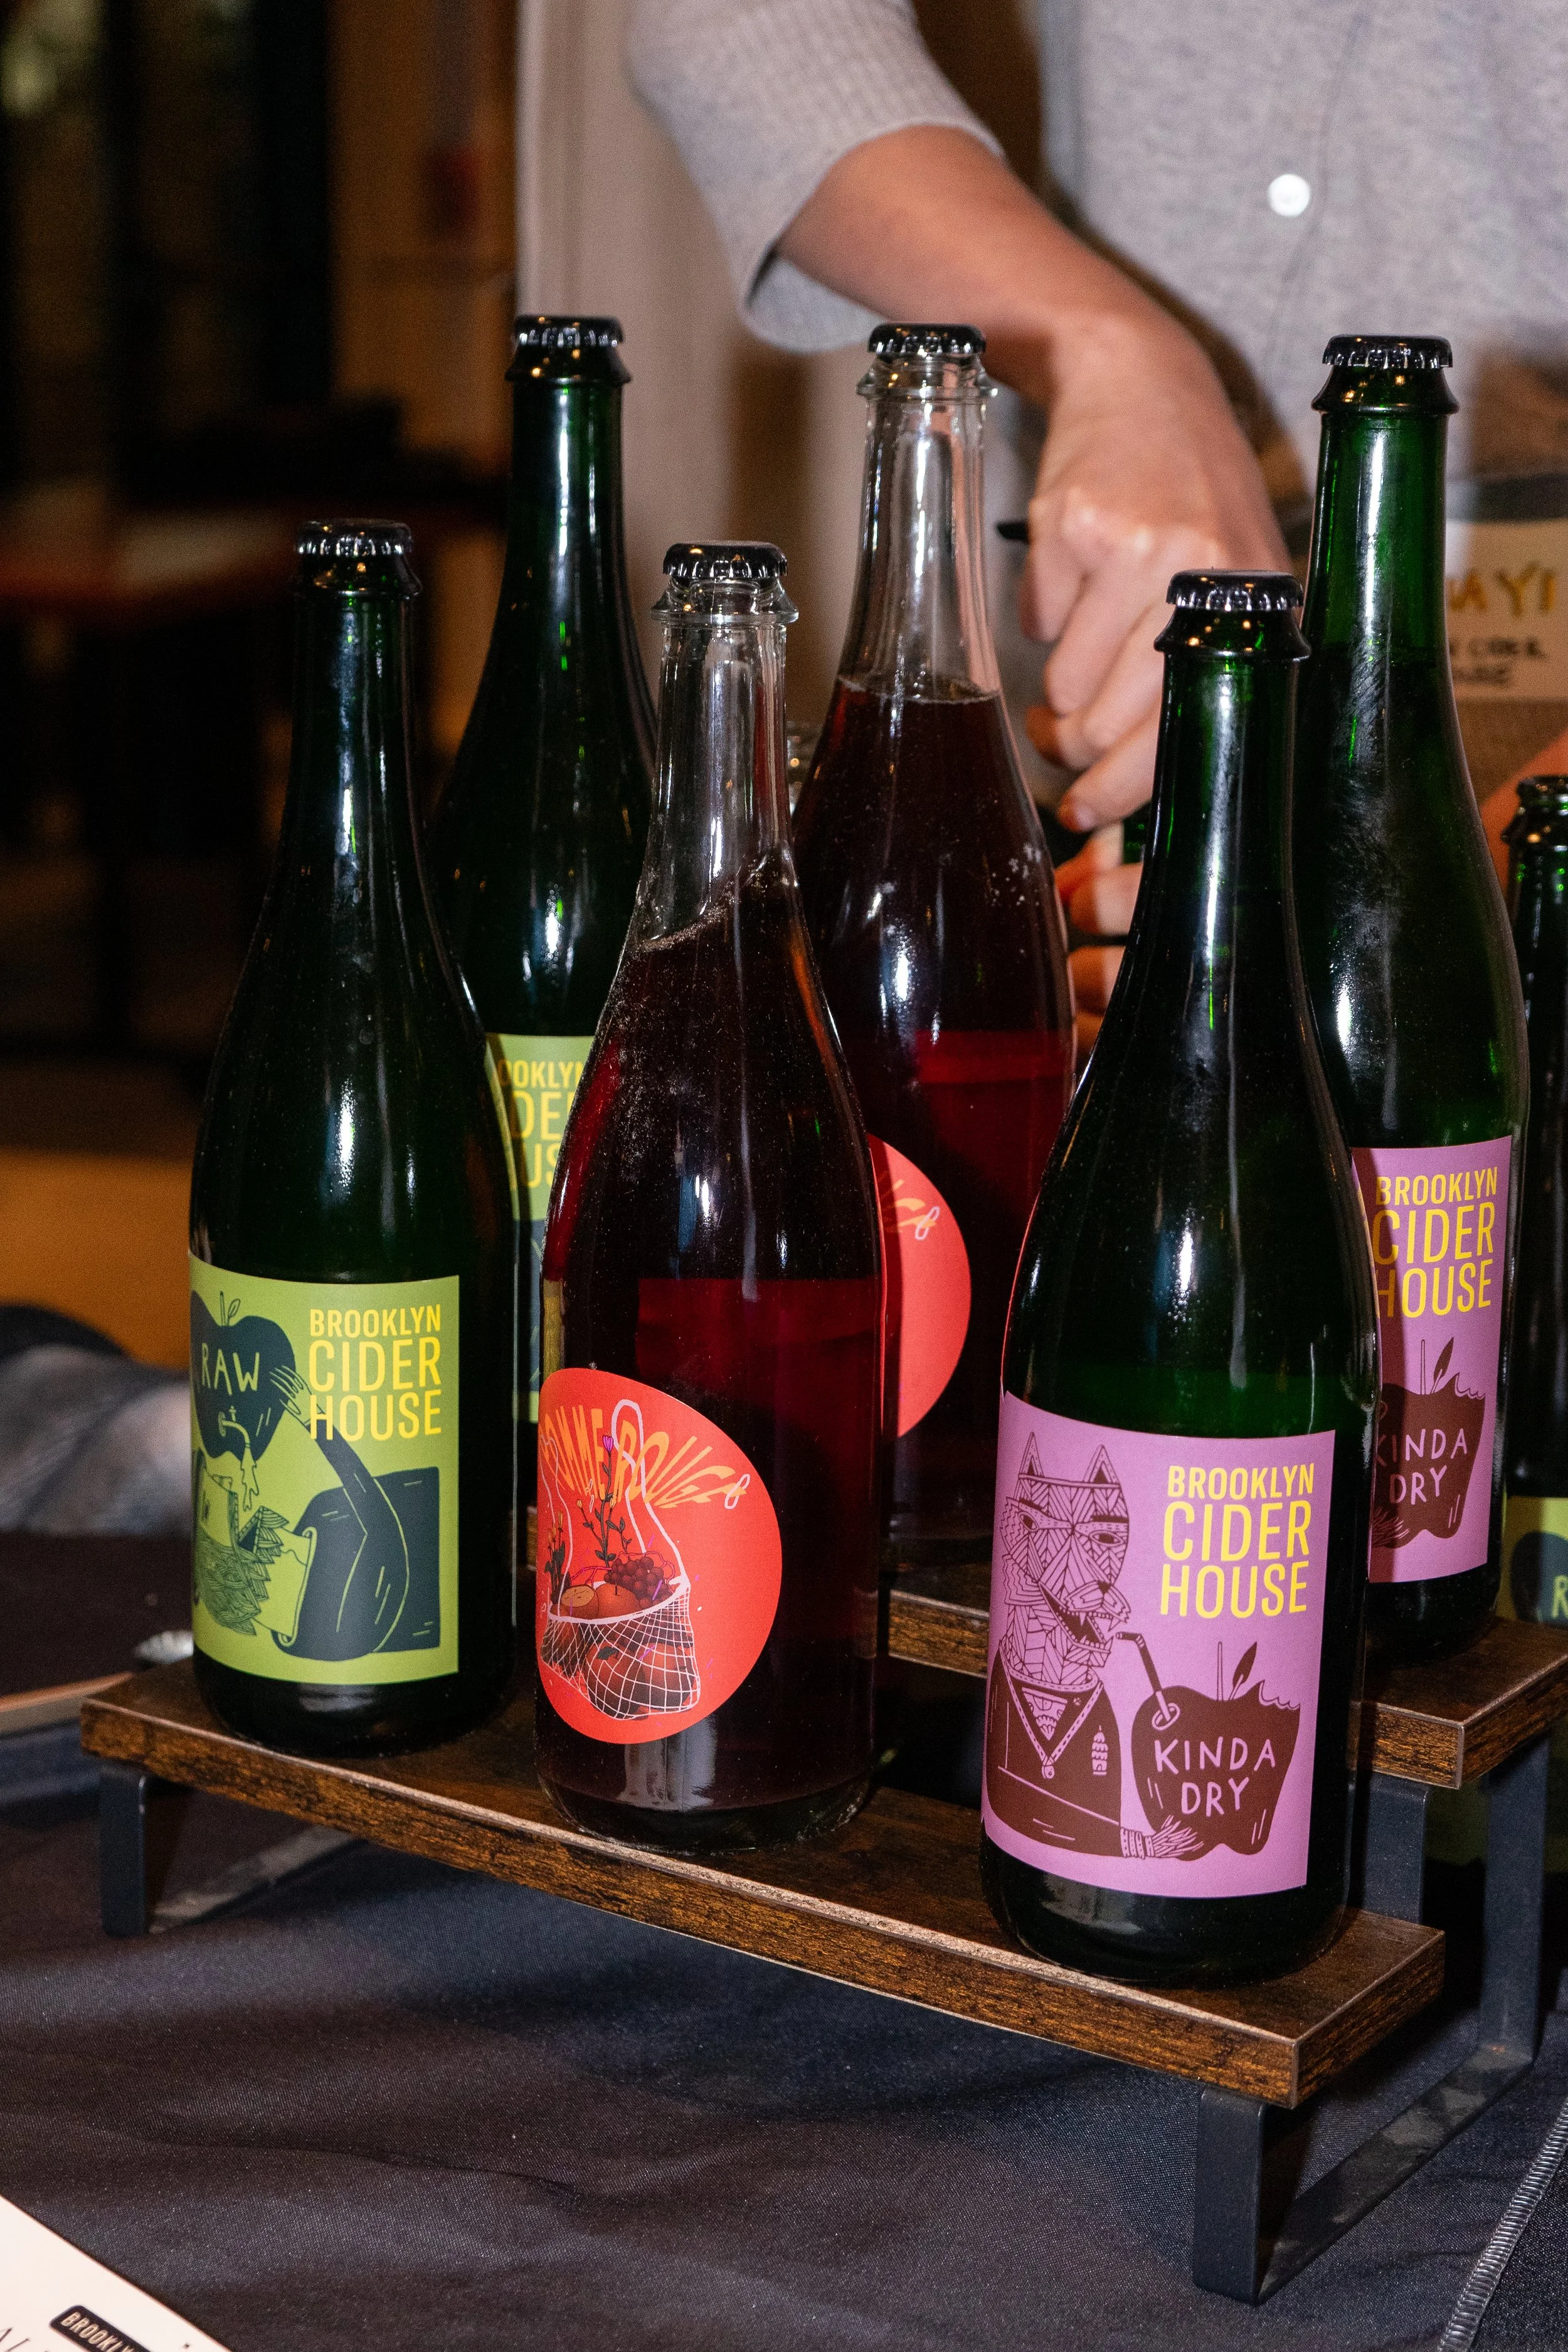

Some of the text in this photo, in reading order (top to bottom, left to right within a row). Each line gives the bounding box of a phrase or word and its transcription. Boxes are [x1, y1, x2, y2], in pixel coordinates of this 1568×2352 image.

[1375, 1167, 1498, 1206] BROOKLYN
[1372, 1201, 1496, 1265] CIDER
[1376, 1258, 1494, 1318] HOUSE
[309, 1304, 441, 1338] BROOKLYN
[201, 1342, 260, 1396] RAW
[308, 1336, 442, 1392] CIDER
[309, 1389, 442, 1442] HOUSE
[1167, 1462, 1315, 1500] BROOKLYN
[1389, 1465, 1448, 1505] DRY
[1163, 1500, 1311, 1562] CIDER
[1160, 1560, 1310, 1619] HOUSE
[1154, 1735, 1276, 1775] KINDA
[1180, 1776, 1249, 1817] DRY
